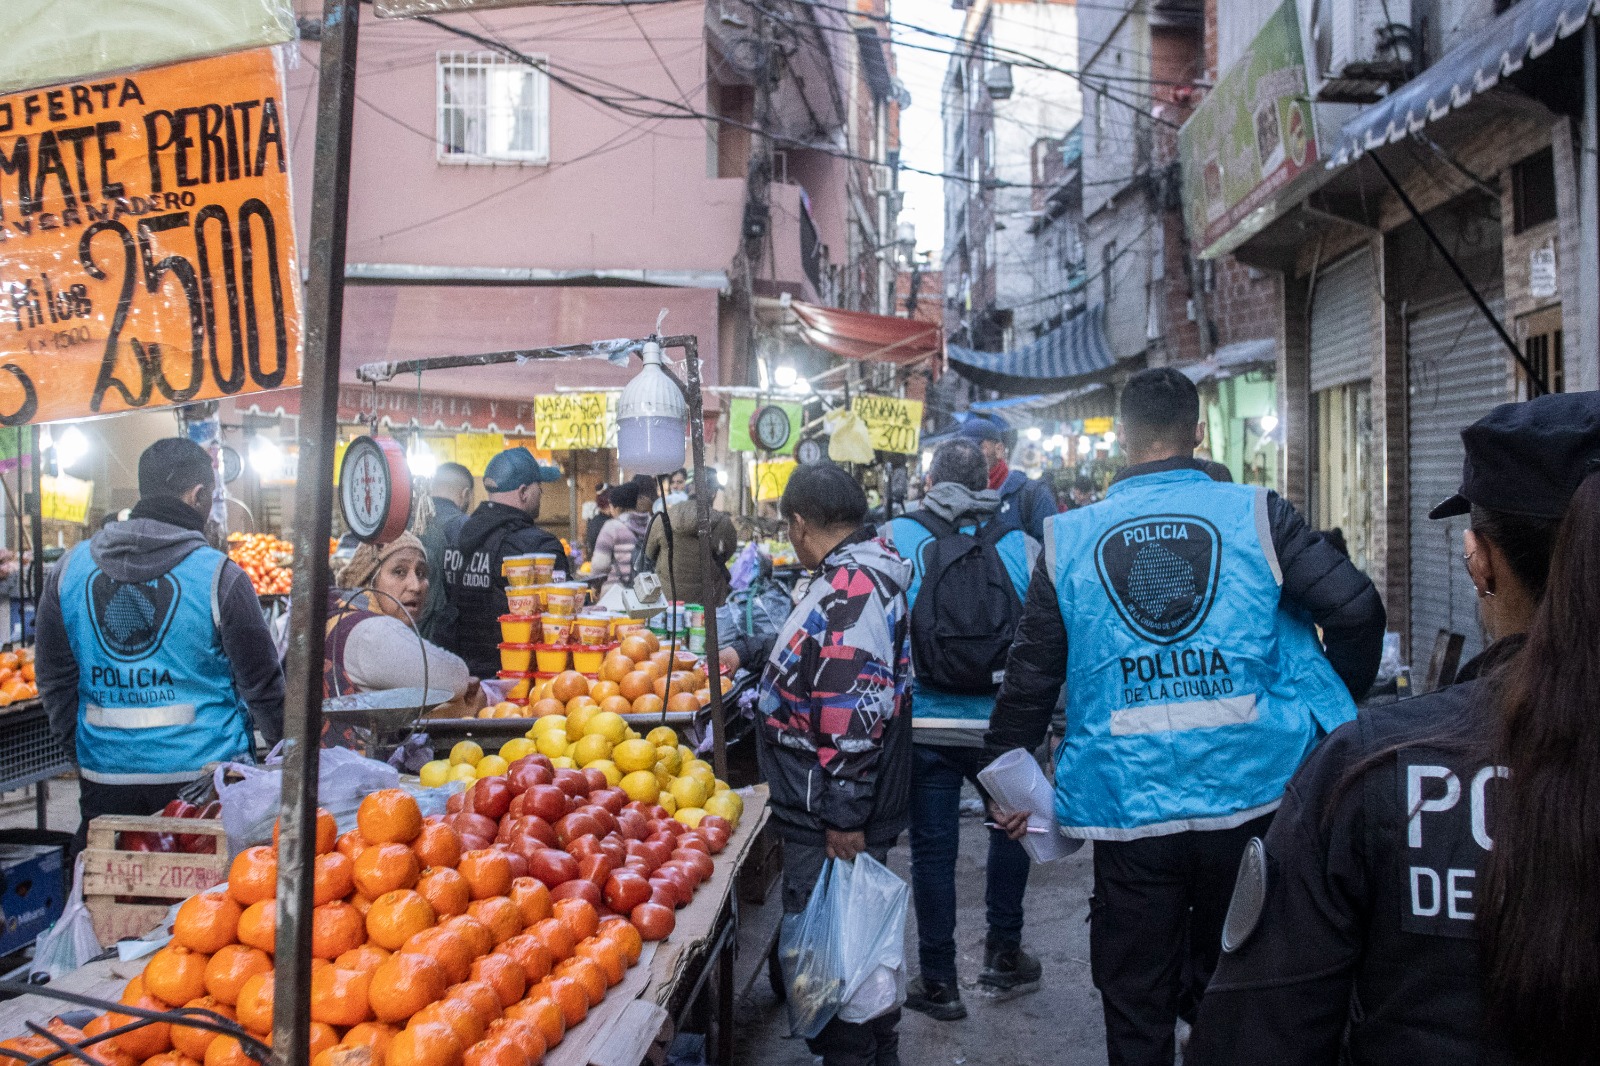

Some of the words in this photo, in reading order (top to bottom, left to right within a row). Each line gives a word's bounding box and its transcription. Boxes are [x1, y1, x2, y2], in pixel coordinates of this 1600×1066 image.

[143, 97, 286, 192] PERITA
[0, 191, 196, 241] VERNADERO
[79, 198, 287, 412] 2500
[534, 396, 602, 413] NARANJA
[854, 396, 909, 418] BANANA
[568, 422, 605, 449] 2000
[877, 424, 916, 451] 3000
[1123, 524, 1189, 546] POLICIA
[443, 549, 490, 574] POCIA
[463, 573, 490, 588] CIUDAD
[91, 666, 174, 689] POLICIA
[1120, 648, 1230, 684] POLICIA
[92, 691, 105, 702] DE
[109, 693, 126, 704] LA
[127, 689, 176, 704] CIUDAD
[1124, 688, 1144, 704] DE
[1147, 685, 1169, 701] LA
[1173, 678, 1234, 698] CIUDAD
[1409, 866, 1476, 921] DE
